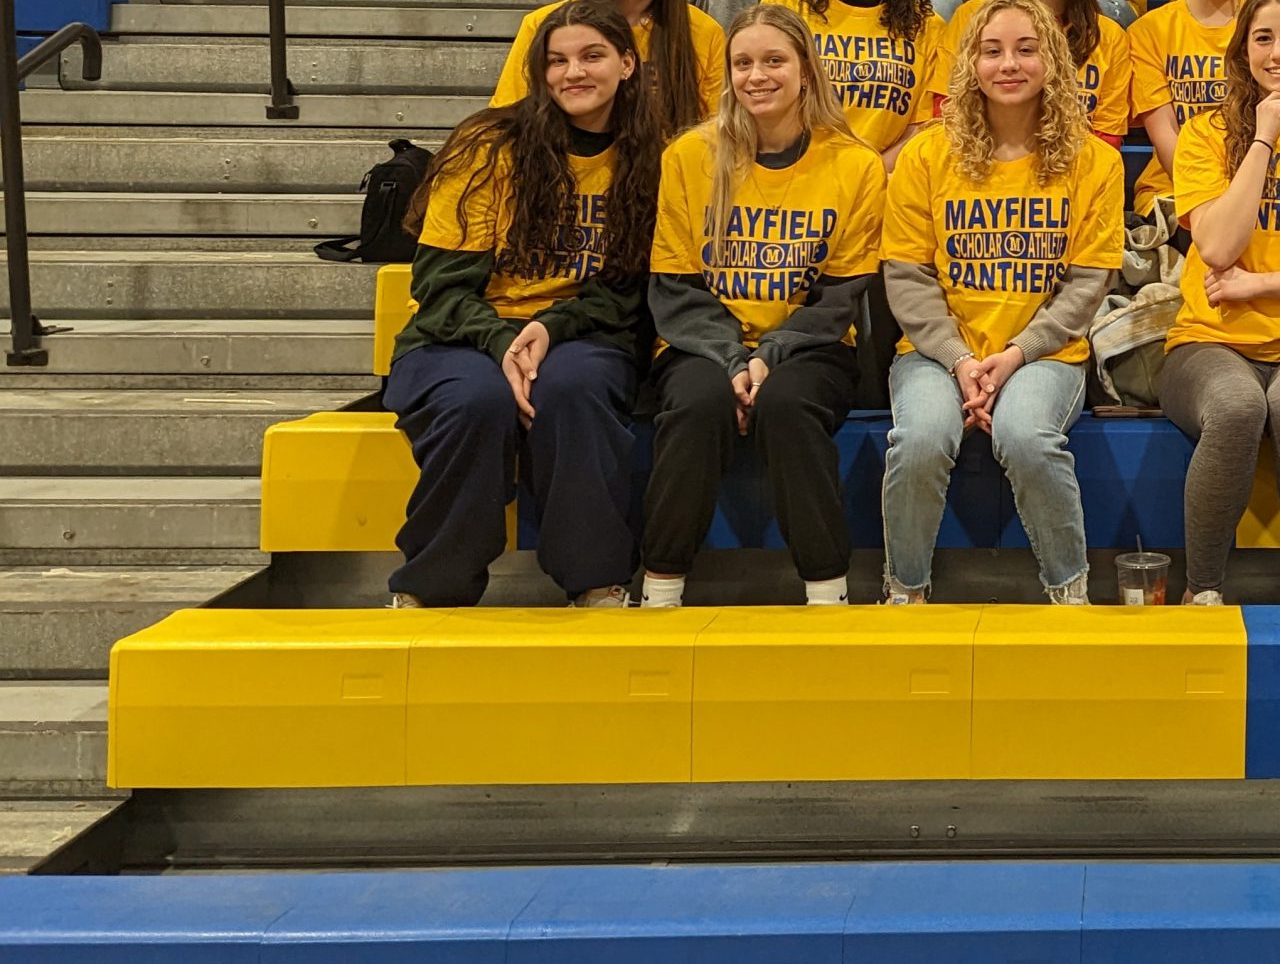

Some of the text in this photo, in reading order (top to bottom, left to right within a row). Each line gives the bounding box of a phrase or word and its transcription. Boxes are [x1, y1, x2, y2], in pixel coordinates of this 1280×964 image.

[823, 59, 851, 81] HOLAR
[875, 62, 910, 87] ATHLETE
[831, 84, 912, 115] NTHERS
[1170, 81, 1206, 102] SCHOLAR
[945, 197, 1070, 231] MAYFIELD
[766, 249, 780, 262] M
[954, 234, 1002, 258] SCHOLAR
[1009, 237, 1020, 252] M
[703, 266, 819, 300] PANTHES
[949, 262, 1067, 293] PANTHERS
